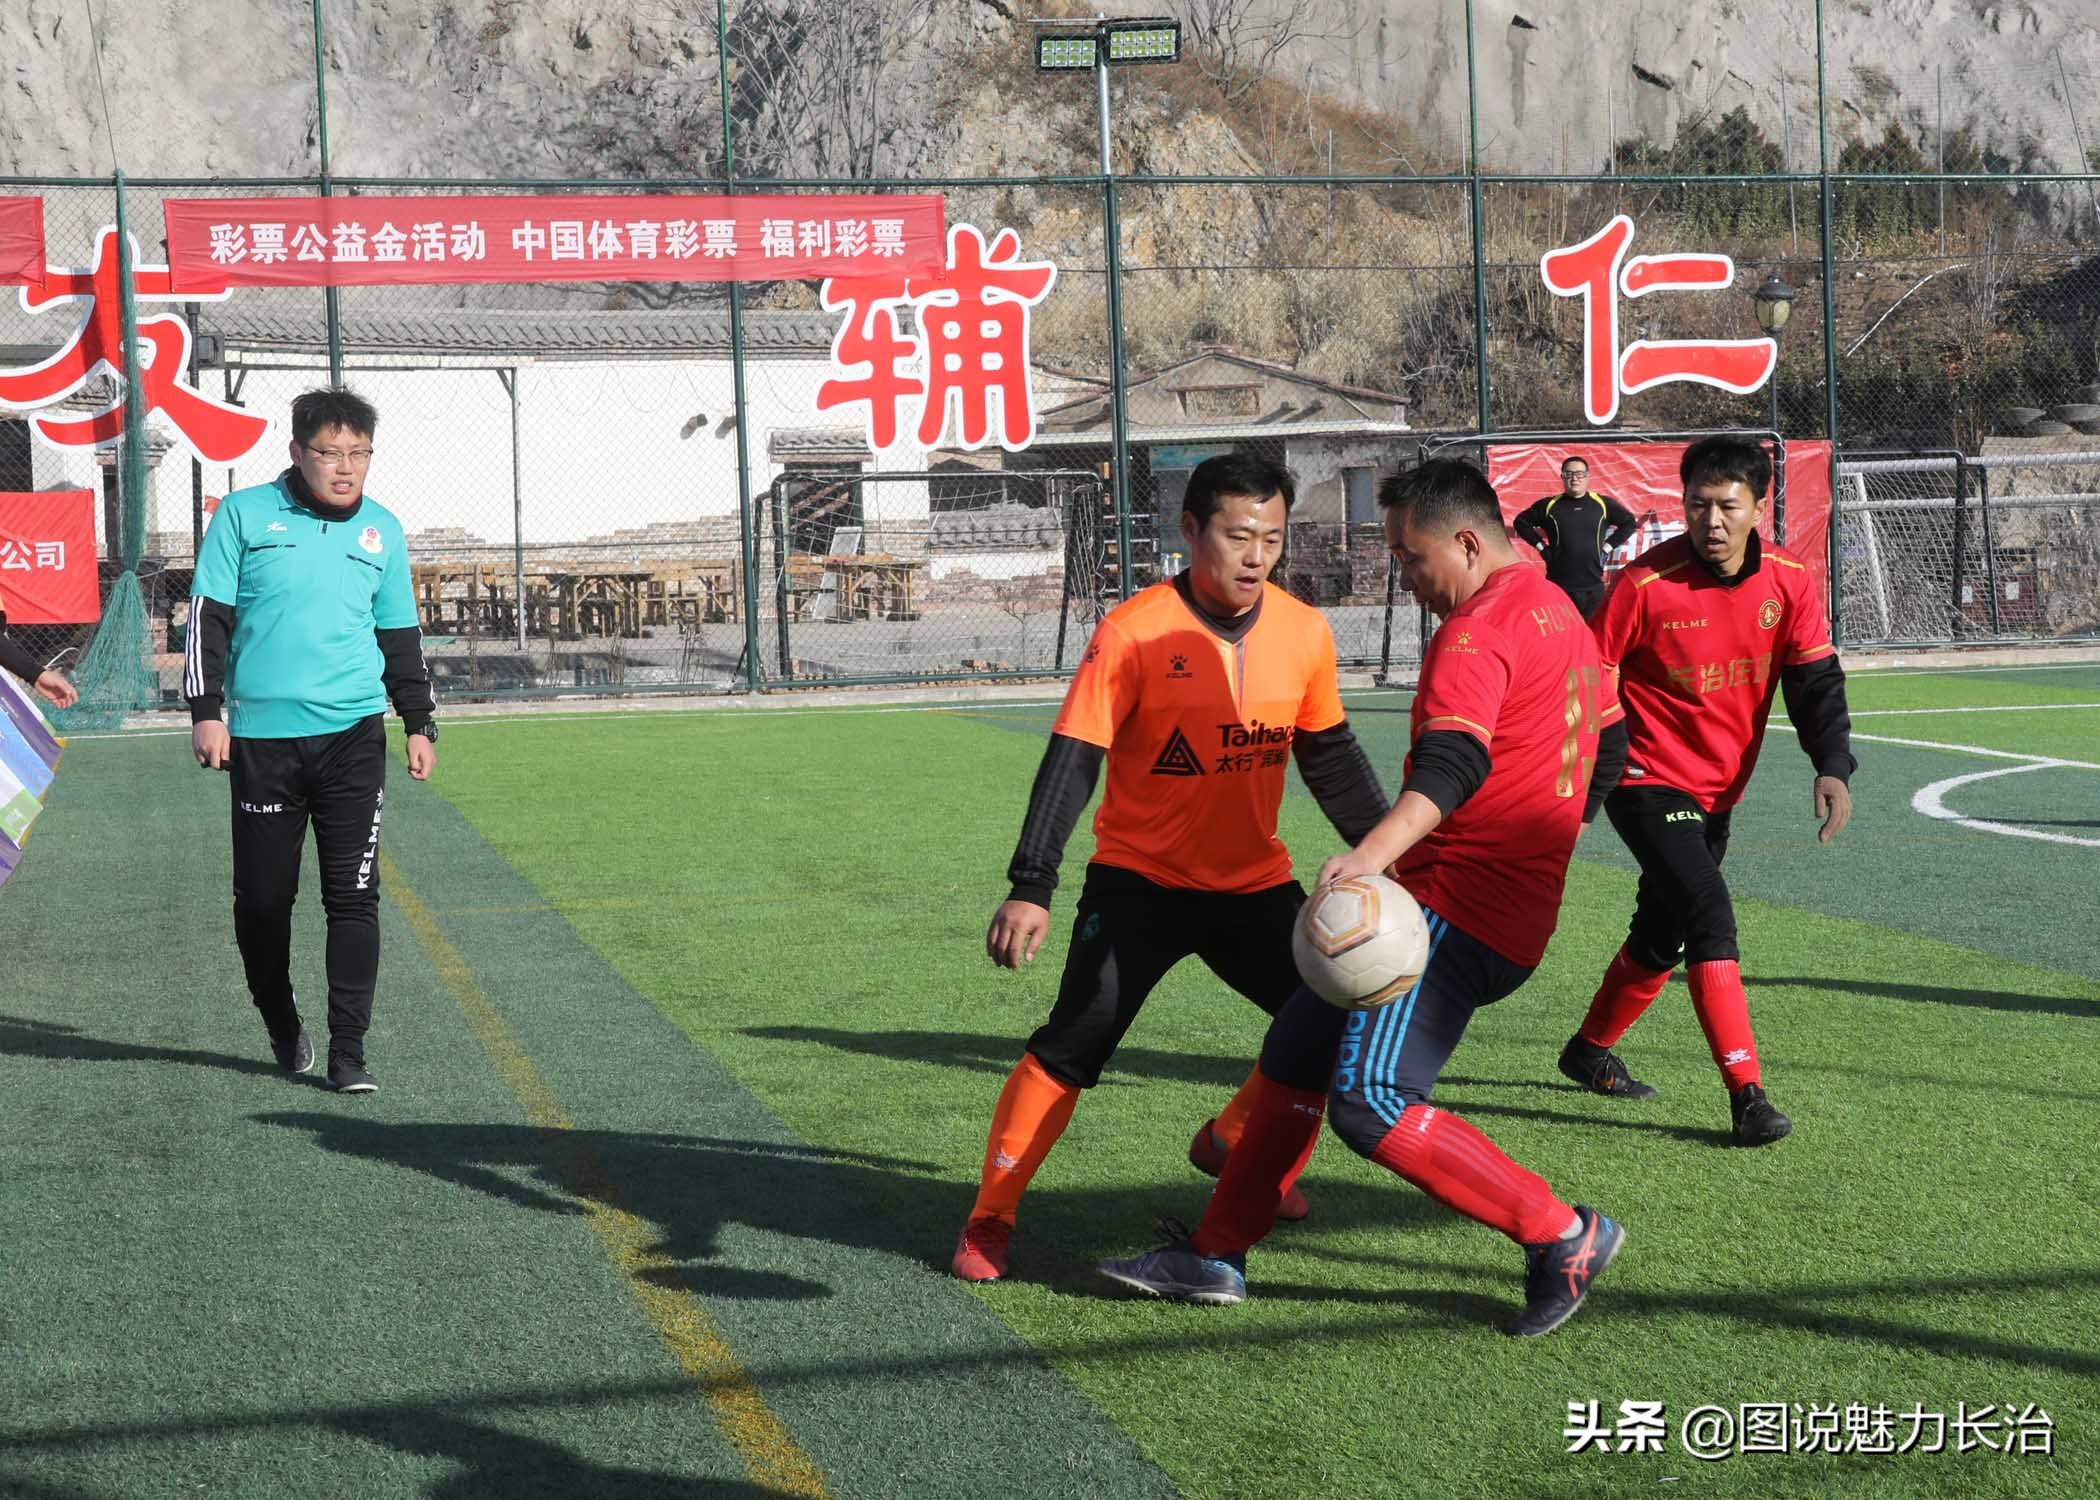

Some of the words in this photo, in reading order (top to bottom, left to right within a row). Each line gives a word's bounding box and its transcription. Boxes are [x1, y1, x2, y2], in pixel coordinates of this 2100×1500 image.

[209, 221, 486, 264] 彩票公益金活动
[511, 219, 738, 261] 中国体育彩票
[760, 218, 907, 257] 福利彩票
[0, 225, 274, 468] 友
[816, 222, 1057, 453] 辅
[1540, 213, 1778, 424] 仁
[0, 541, 65, 571] 公司
[1662, 618, 1709, 630] KELME
[356, 809, 384, 889] KELME
